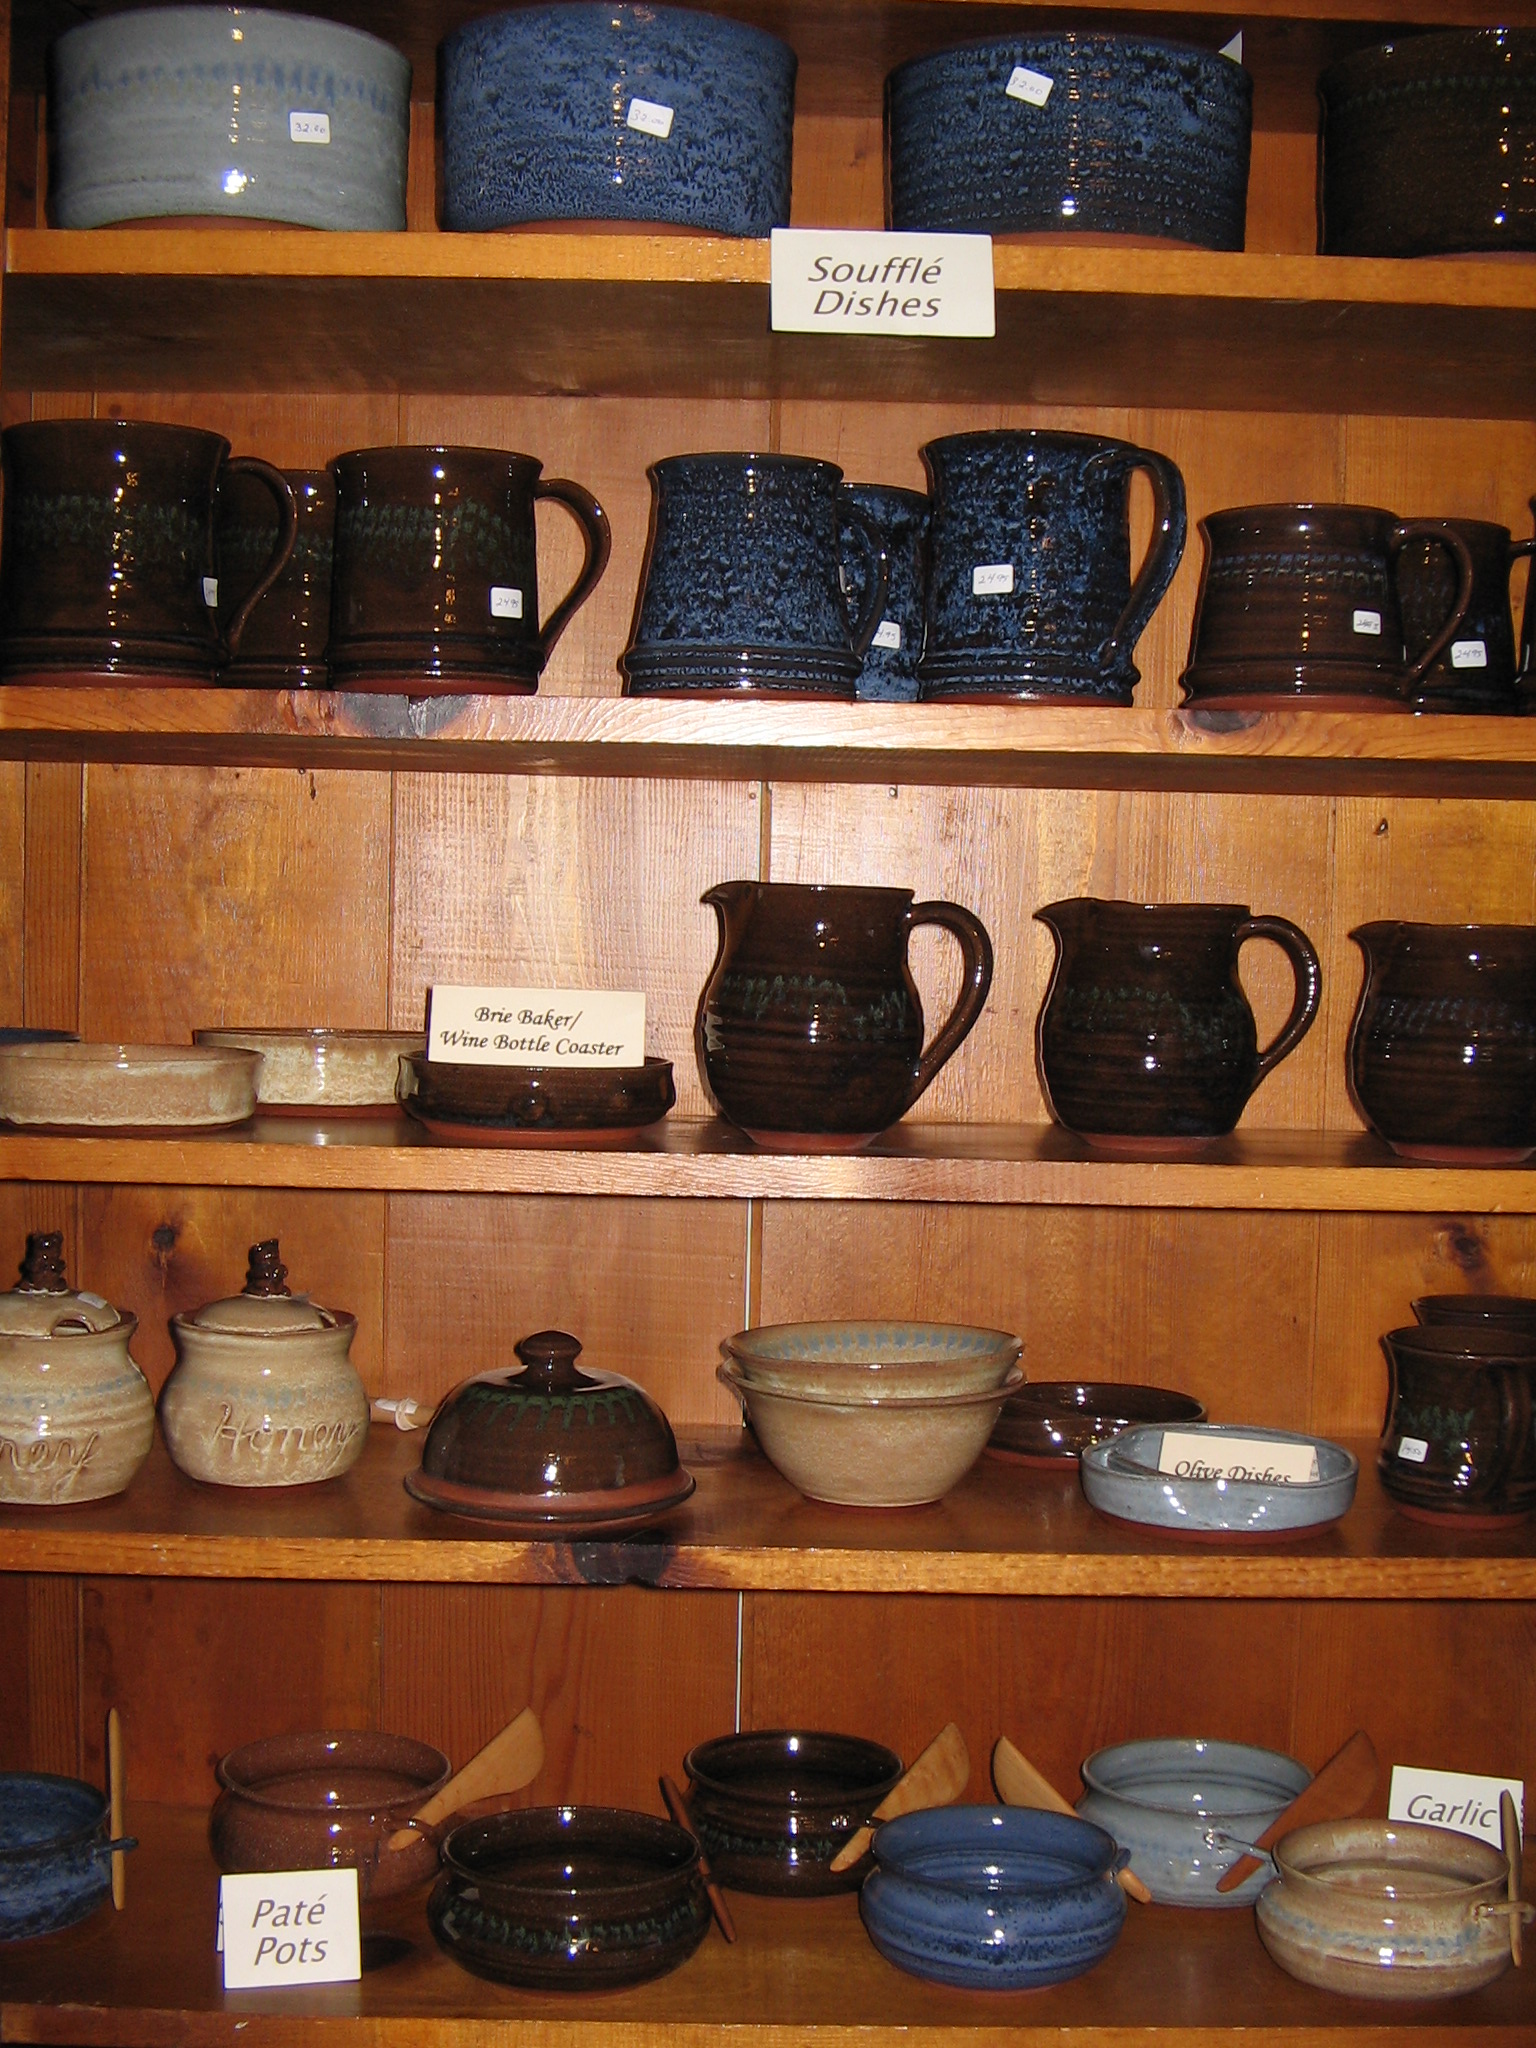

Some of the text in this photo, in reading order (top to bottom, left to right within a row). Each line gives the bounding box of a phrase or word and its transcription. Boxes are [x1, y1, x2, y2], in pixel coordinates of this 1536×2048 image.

[807, 256, 944, 285] Soufflé
[813, 290, 942, 318] Dishes
[474, 1006, 583, 1032] Brie Baker/
[440, 1030, 624, 1056] Wine Bottle Coaster
[1174, 1459, 1223, 1479] Olive
[1227, 1465, 1292, 1484] Dishes
[1407, 1794, 1497, 1828] Garlic
[252, 1893, 328, 1929] Paté
[254, 1936, 329, 1966] Pots
